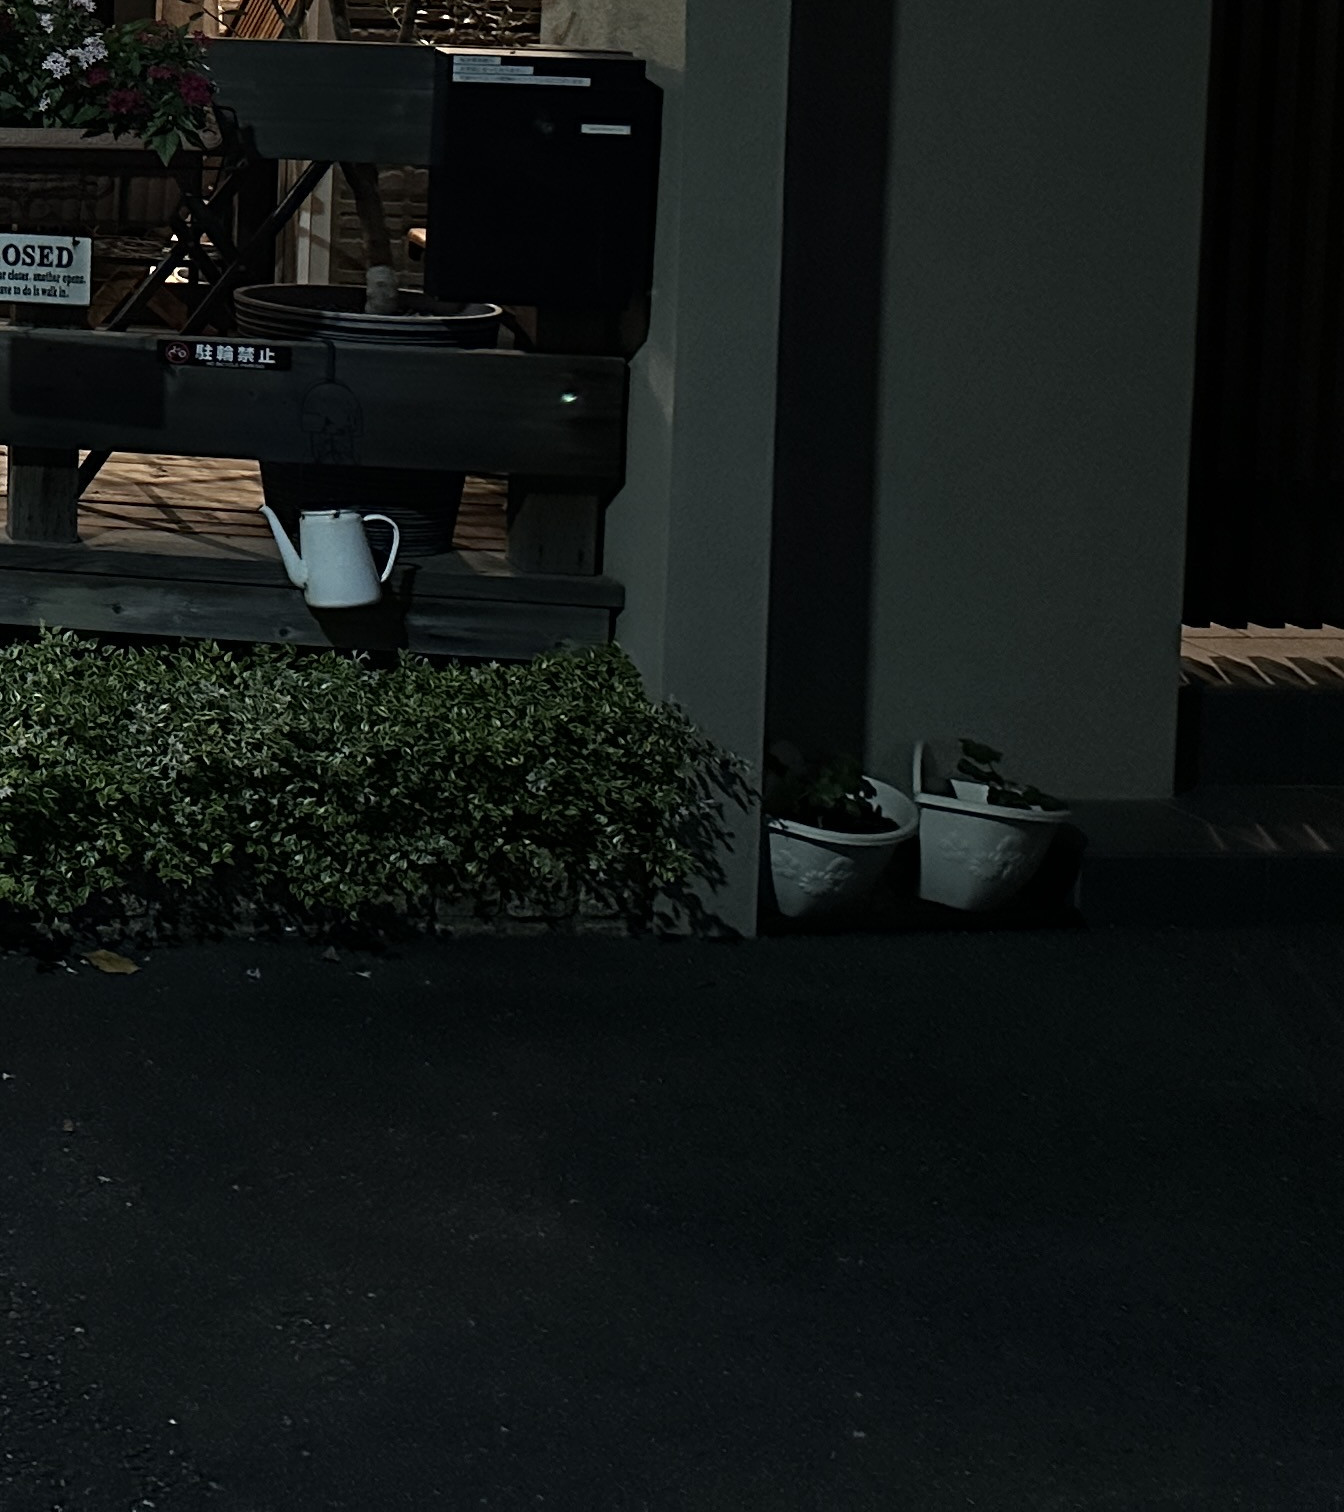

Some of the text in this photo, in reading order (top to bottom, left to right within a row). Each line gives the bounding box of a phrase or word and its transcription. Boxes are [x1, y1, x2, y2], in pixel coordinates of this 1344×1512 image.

[33, 271, 60, 283] another
[13, 284, 21, 295] to
[22, 284, 32, 296] do
[41, 285, 58, 297] walk
[194, 343, 277, 364] 駐輪禁止
